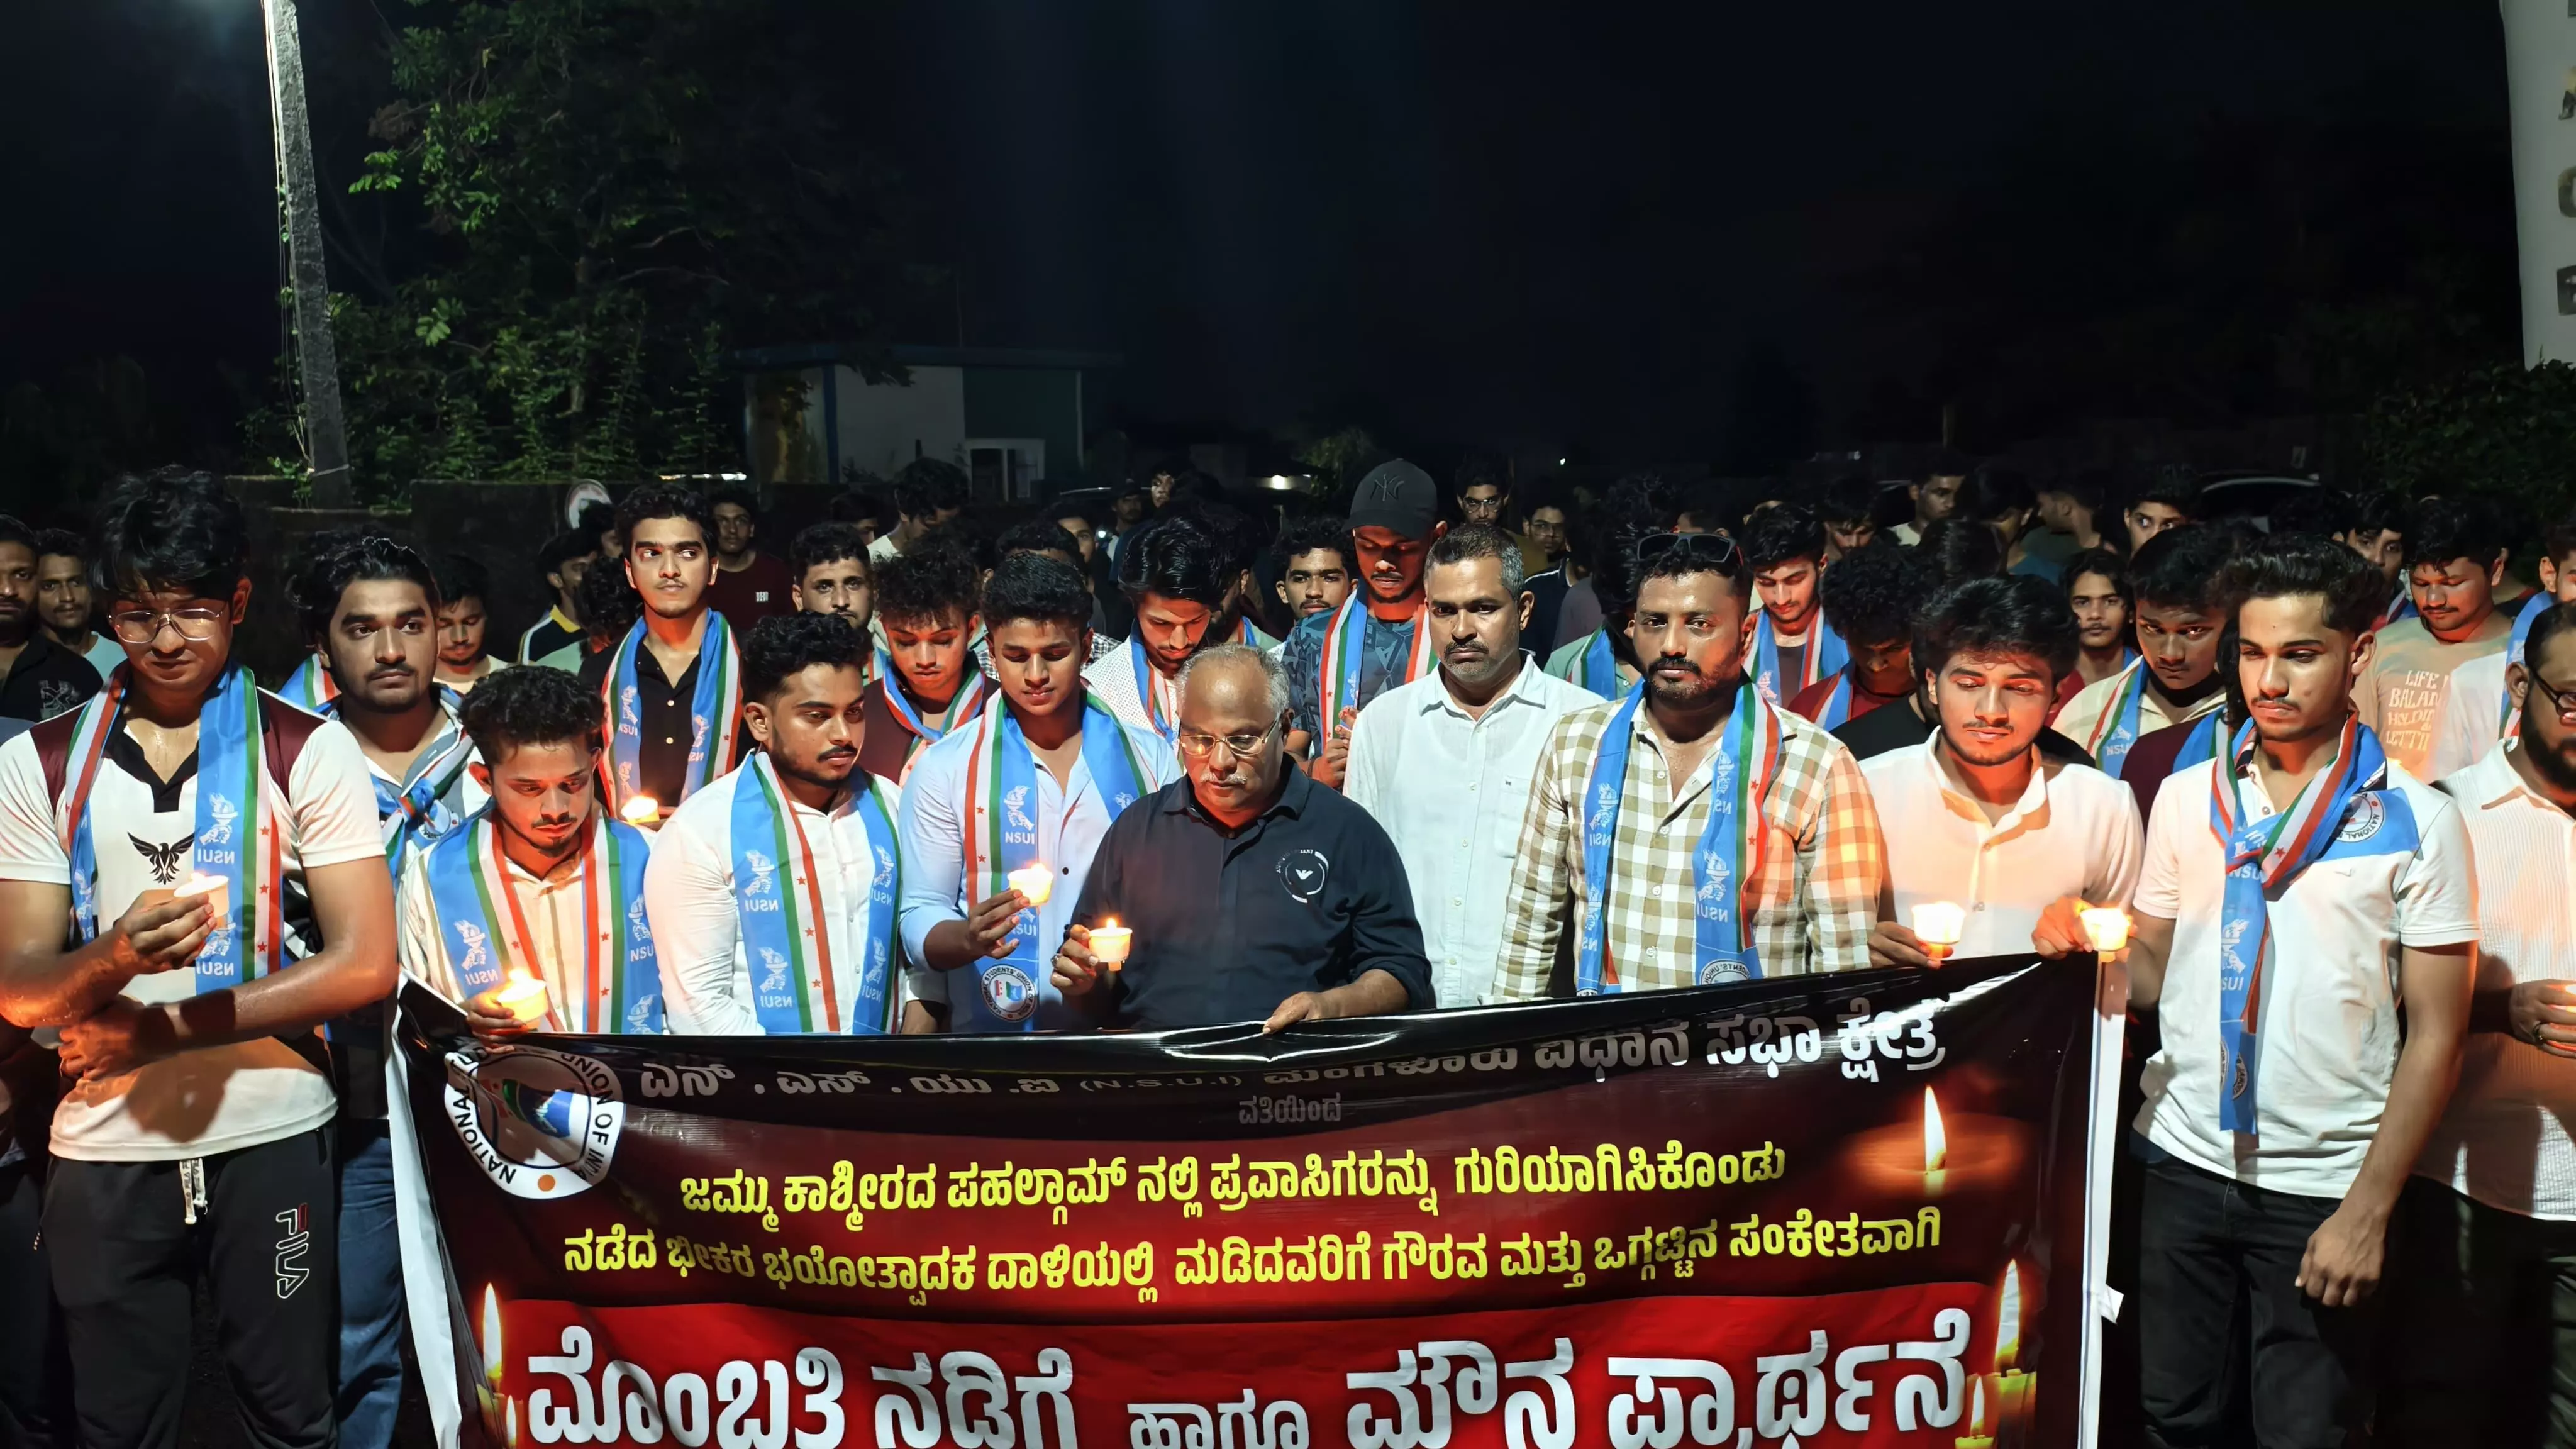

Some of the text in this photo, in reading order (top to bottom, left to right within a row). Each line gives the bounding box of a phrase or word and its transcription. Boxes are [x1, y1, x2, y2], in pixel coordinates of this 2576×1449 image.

[2404, 670, 2440, 690] LIFE
[1005, 831, 1035, 845] NSUI
[630, 945, 655, 962] NSU
[2221, 977, 2245, 991] SUI
[641, 1062, 736, 1098] ಎನ್
[776, 1070, 871, 1094] ಎಸ್
[1706, 1012, 1823, 1079] ಸಭಾ
[591, 1113, 613, 1146] OF
[680, 1139, 1787, 1232] ಜಮ್ಮು ಕಾಶ್ಮೀರದ ಪಹಲ್ಗಾಮ್ ನಲ್ಲಿ ಪ್ರವಾಸಿಗರನ್ನು ಗುರಿಯಾಗಿಸಿಕೊಂಡು
[275, 1202, 309, 1300] FILA
[564, 1206, 1941, 1307] ನಡೆದ ಭೀಕರ ಭಯೋತ್ಪಾದಕ ದಾಳಿಯಲ್ಲಿ ಮಡಿದವರಿಗೆ ಗೌರವ ಮತ್ತು ಒಗ್ಗಟ್ಟಿನ ಸಂಕೇತವಾಗಿ
